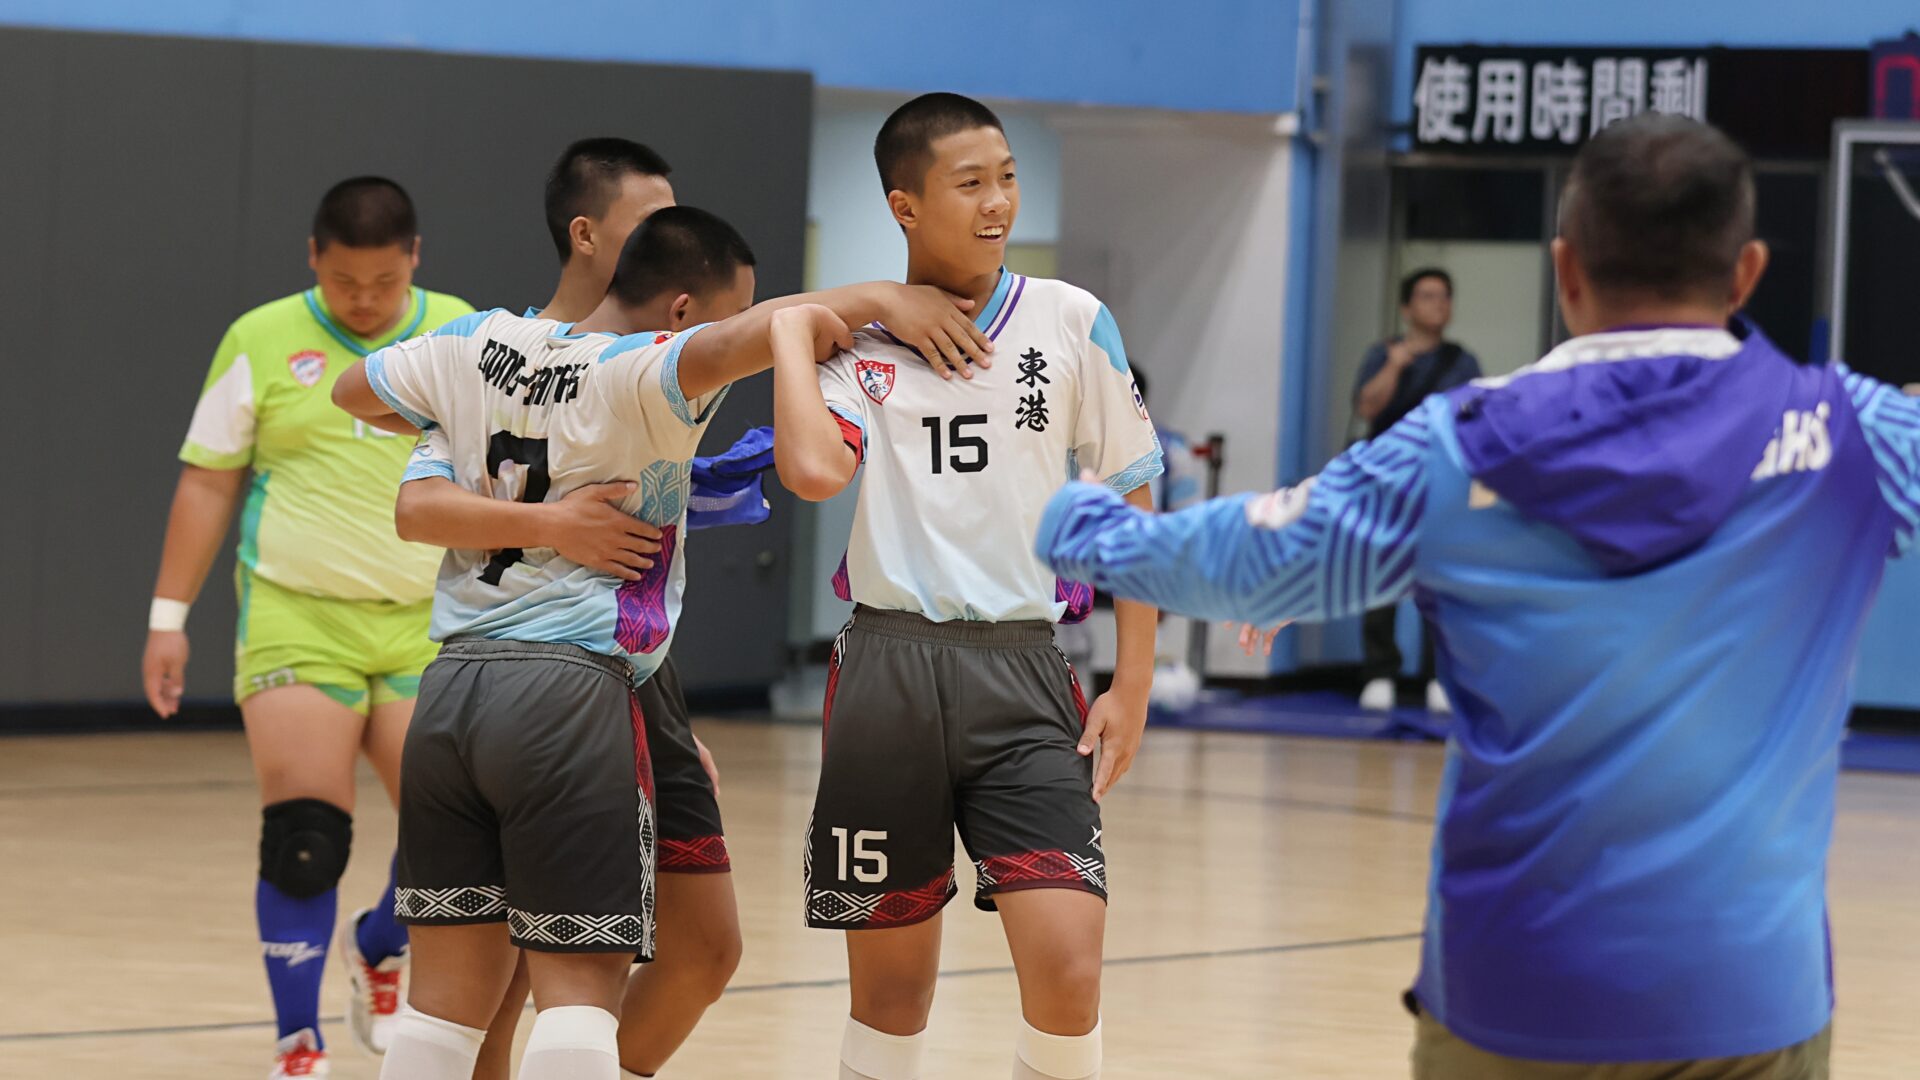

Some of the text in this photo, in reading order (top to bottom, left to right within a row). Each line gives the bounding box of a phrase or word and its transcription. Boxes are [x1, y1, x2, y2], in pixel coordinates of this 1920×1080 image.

[1015, 347, 1051, 433] 東港
[922, 414, 989, 474] 15
[831, 827, 889, 883] 15
